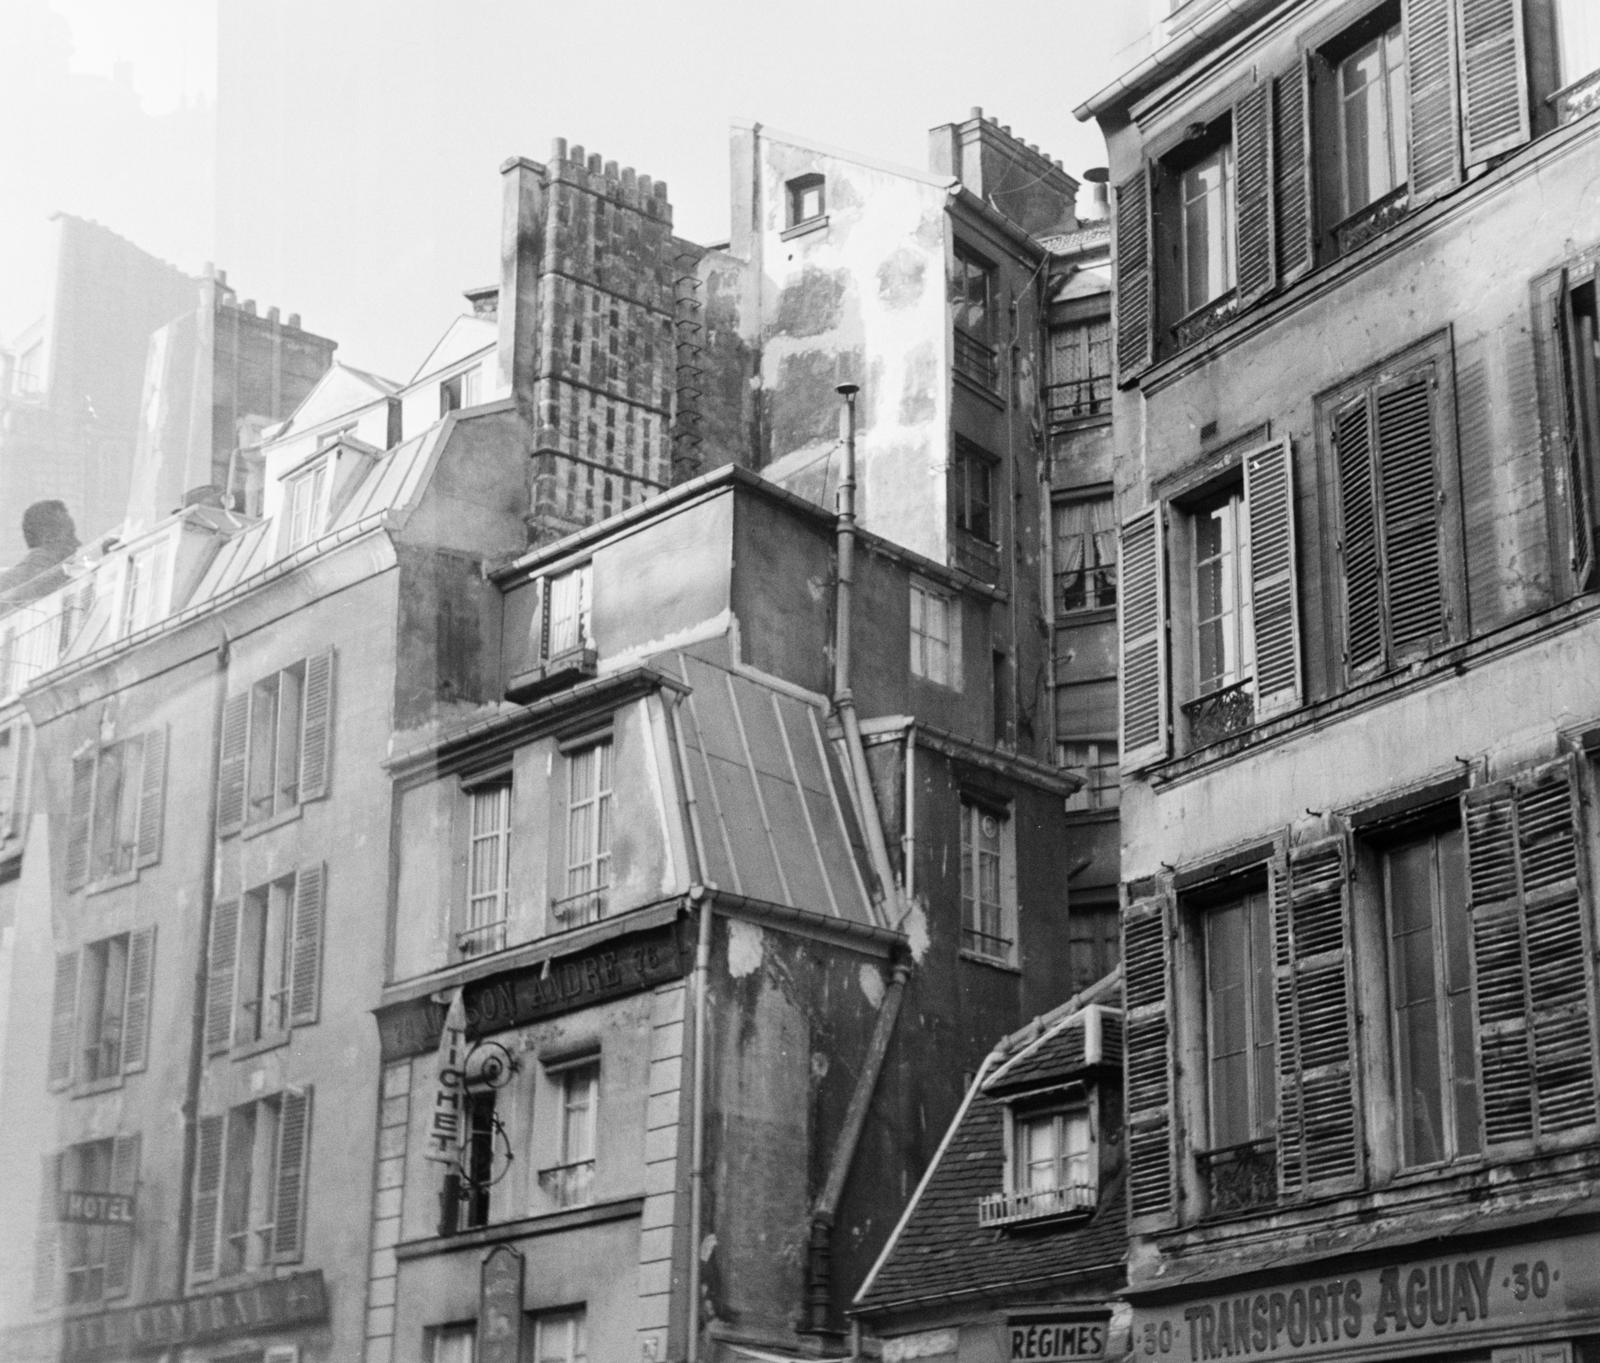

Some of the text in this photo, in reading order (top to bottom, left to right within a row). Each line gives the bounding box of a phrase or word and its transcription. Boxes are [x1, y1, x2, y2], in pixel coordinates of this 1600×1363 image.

[1011, 1325, 1101, 1359] RÉGIMES
[1184, 1278, 1363, 1362] TRANSPORTS
[1373, 1256, 1496, 1336] AGUAY
